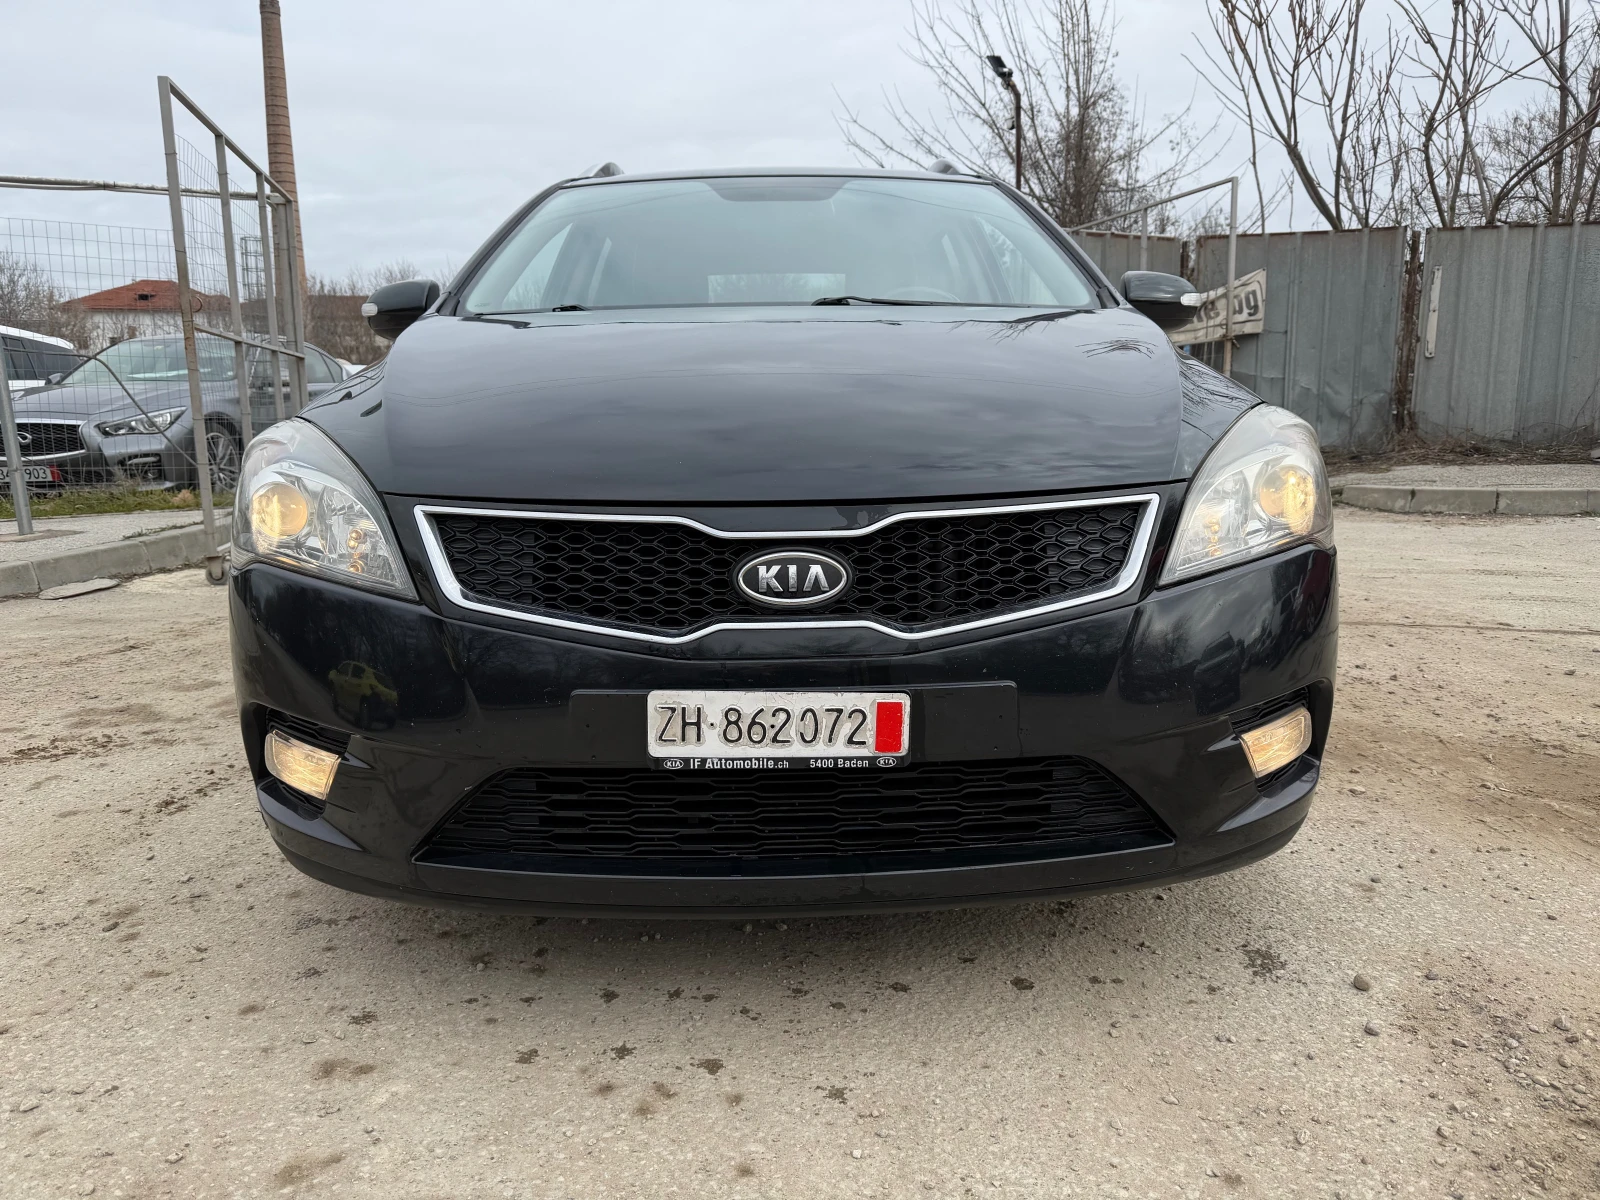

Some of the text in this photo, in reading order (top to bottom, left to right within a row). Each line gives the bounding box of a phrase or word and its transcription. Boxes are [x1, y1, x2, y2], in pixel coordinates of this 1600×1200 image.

[24, 467, 48, 480] 903
[756, 564, 830, 592] KIA
[666, 760, 682, 768] KIA
[690, 758, 701, 769] IF
[705, 757, 789, 769] Automobile.ch
[810, 759, 834, 768] 5400
[837, 758, 869, 768] Baden
